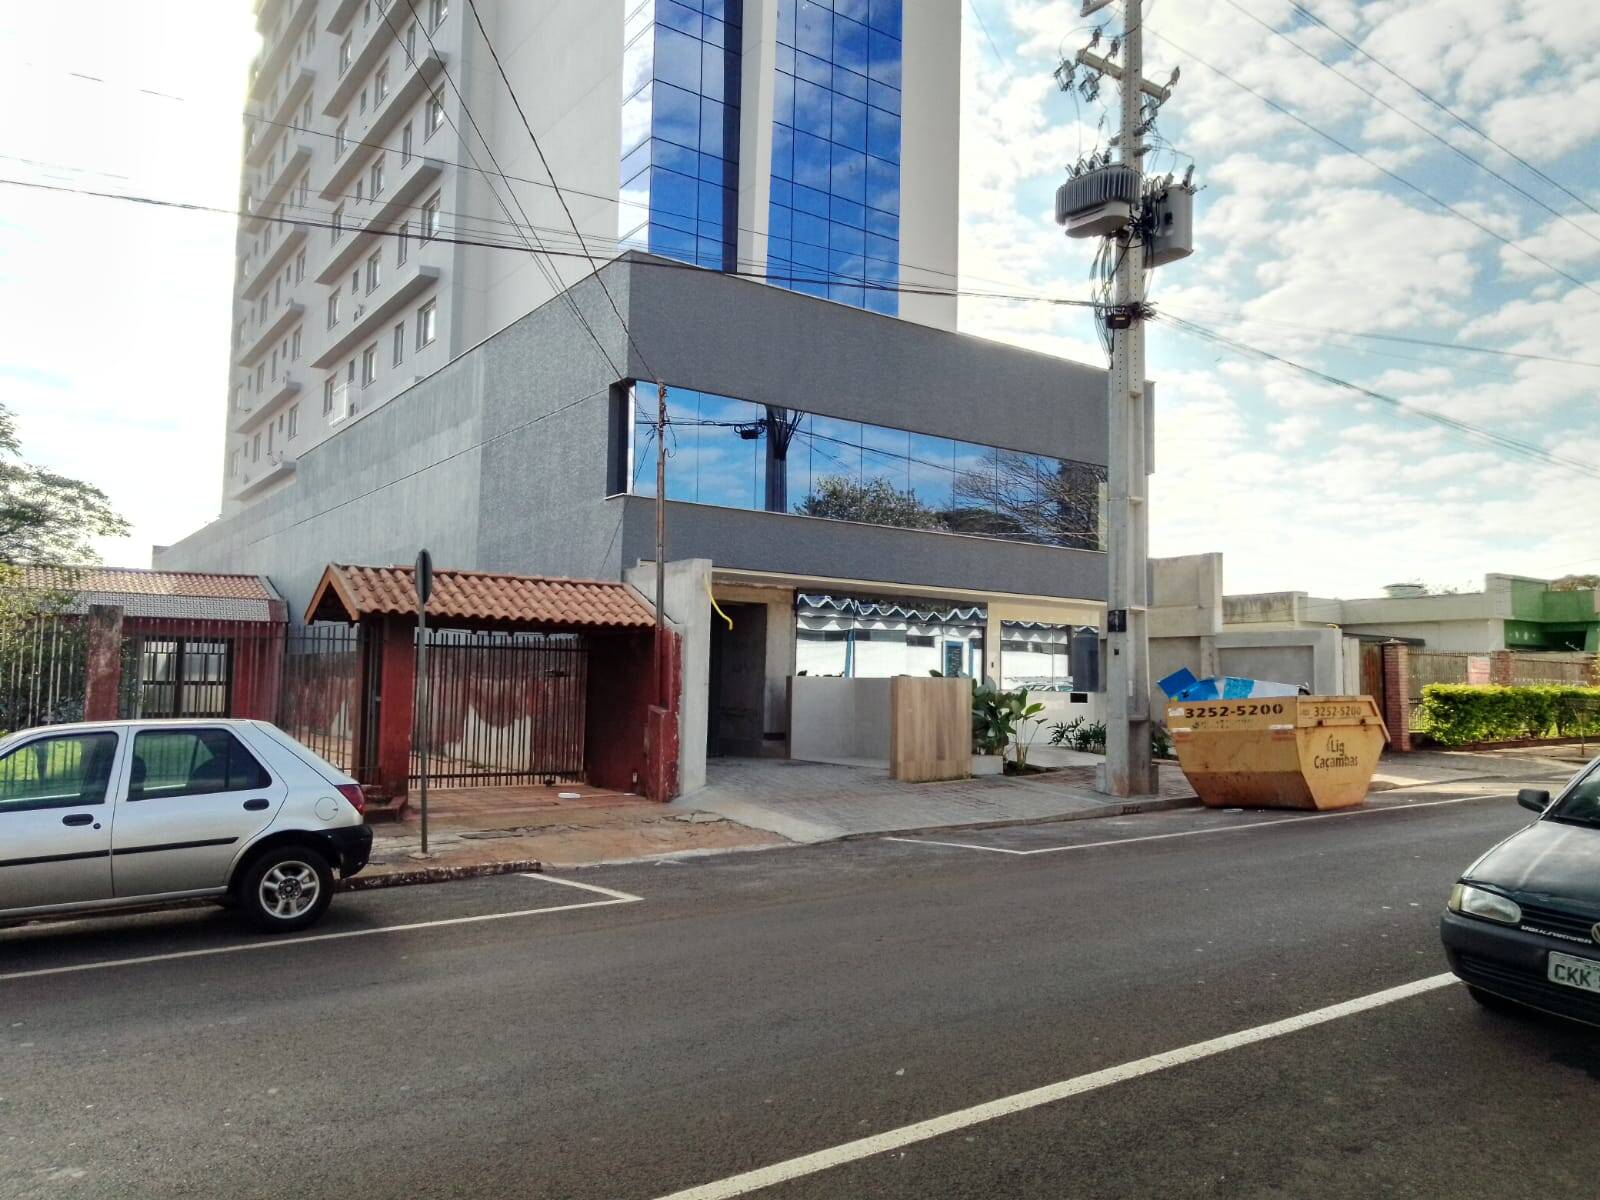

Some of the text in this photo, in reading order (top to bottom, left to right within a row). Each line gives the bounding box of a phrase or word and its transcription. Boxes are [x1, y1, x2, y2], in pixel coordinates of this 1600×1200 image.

[1185, 703, 1284, 719] 3252-5200
[1314, 706, 1361, 717] 3252-5200
[1330, 739, 1345, 756] Lig
[1314, 755, 1359, 771] Caçambas
[1554, 963, 1591, 987] CKK
